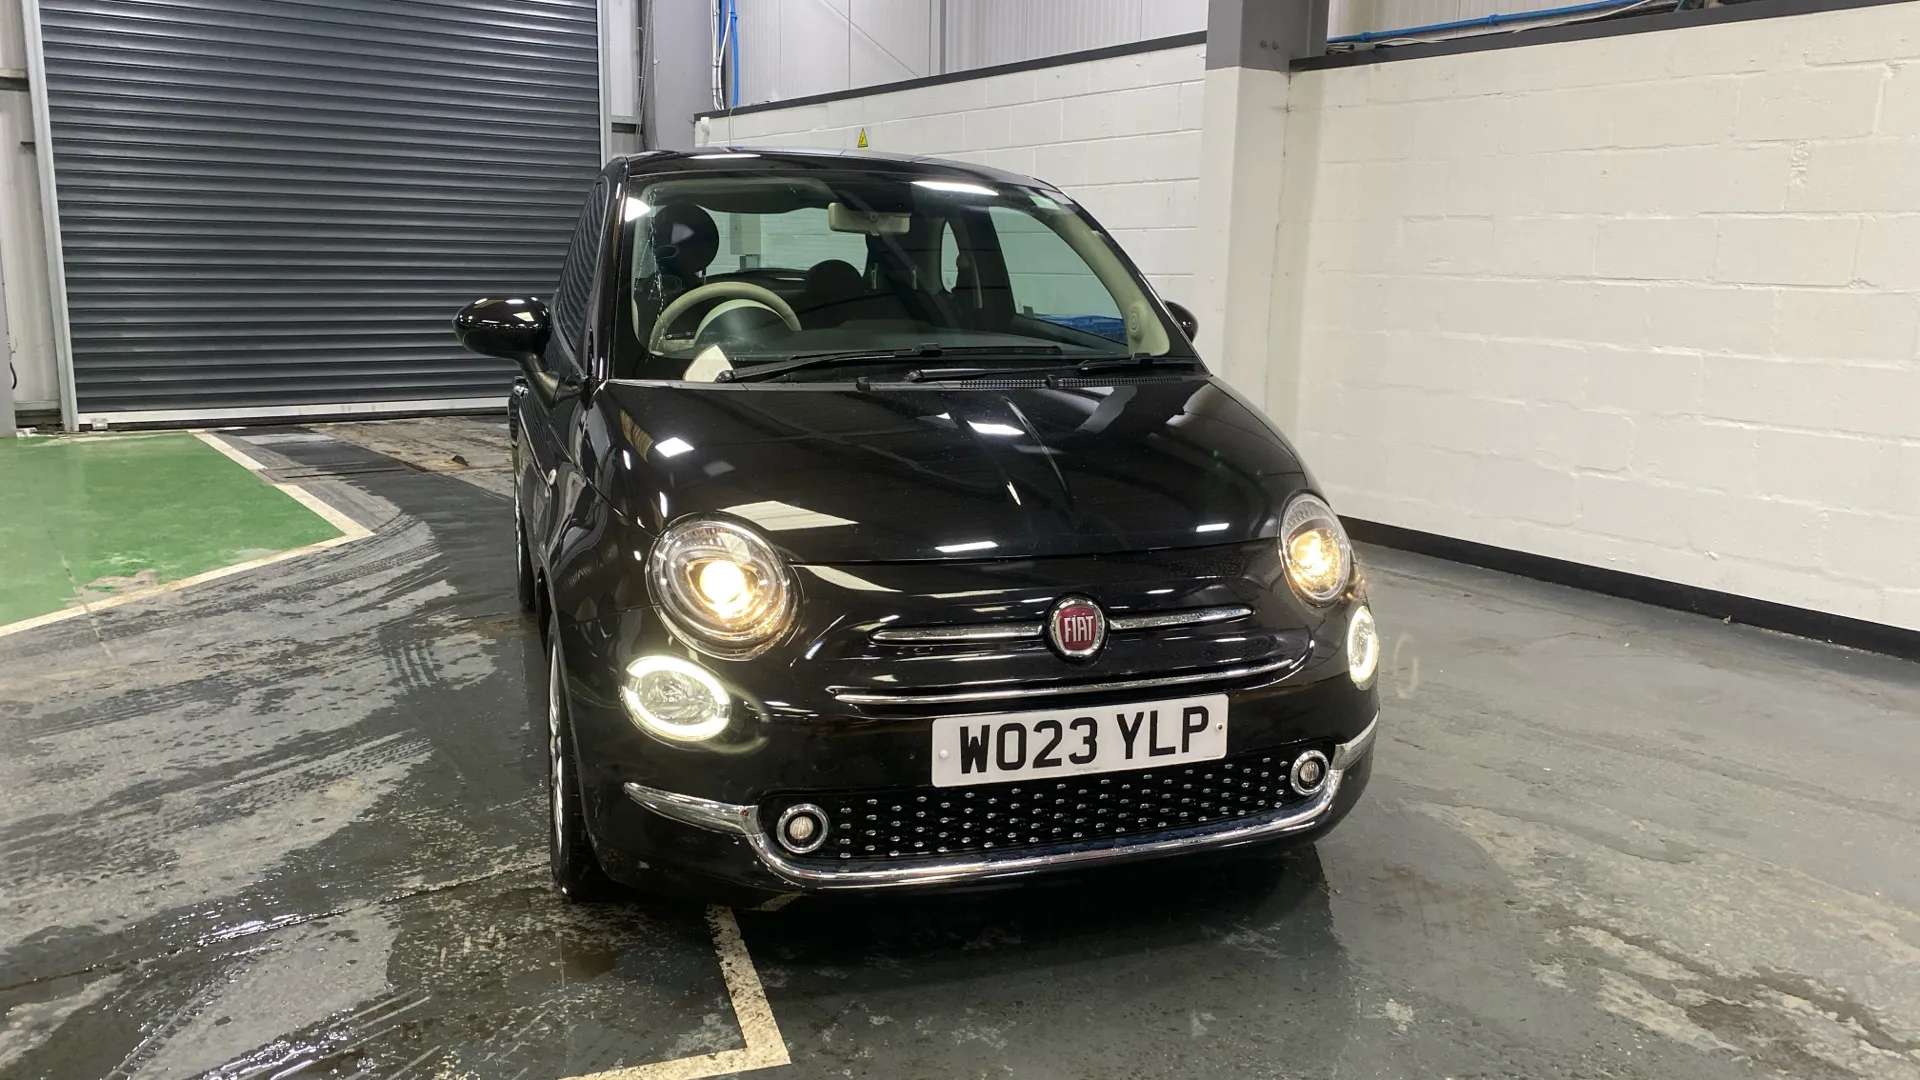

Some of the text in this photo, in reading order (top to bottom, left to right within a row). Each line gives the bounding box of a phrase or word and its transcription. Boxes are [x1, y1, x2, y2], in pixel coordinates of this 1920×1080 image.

[1064, 615, 1094, 643] FIAT
[959, 705, 1209, 774] WO23 YLP
